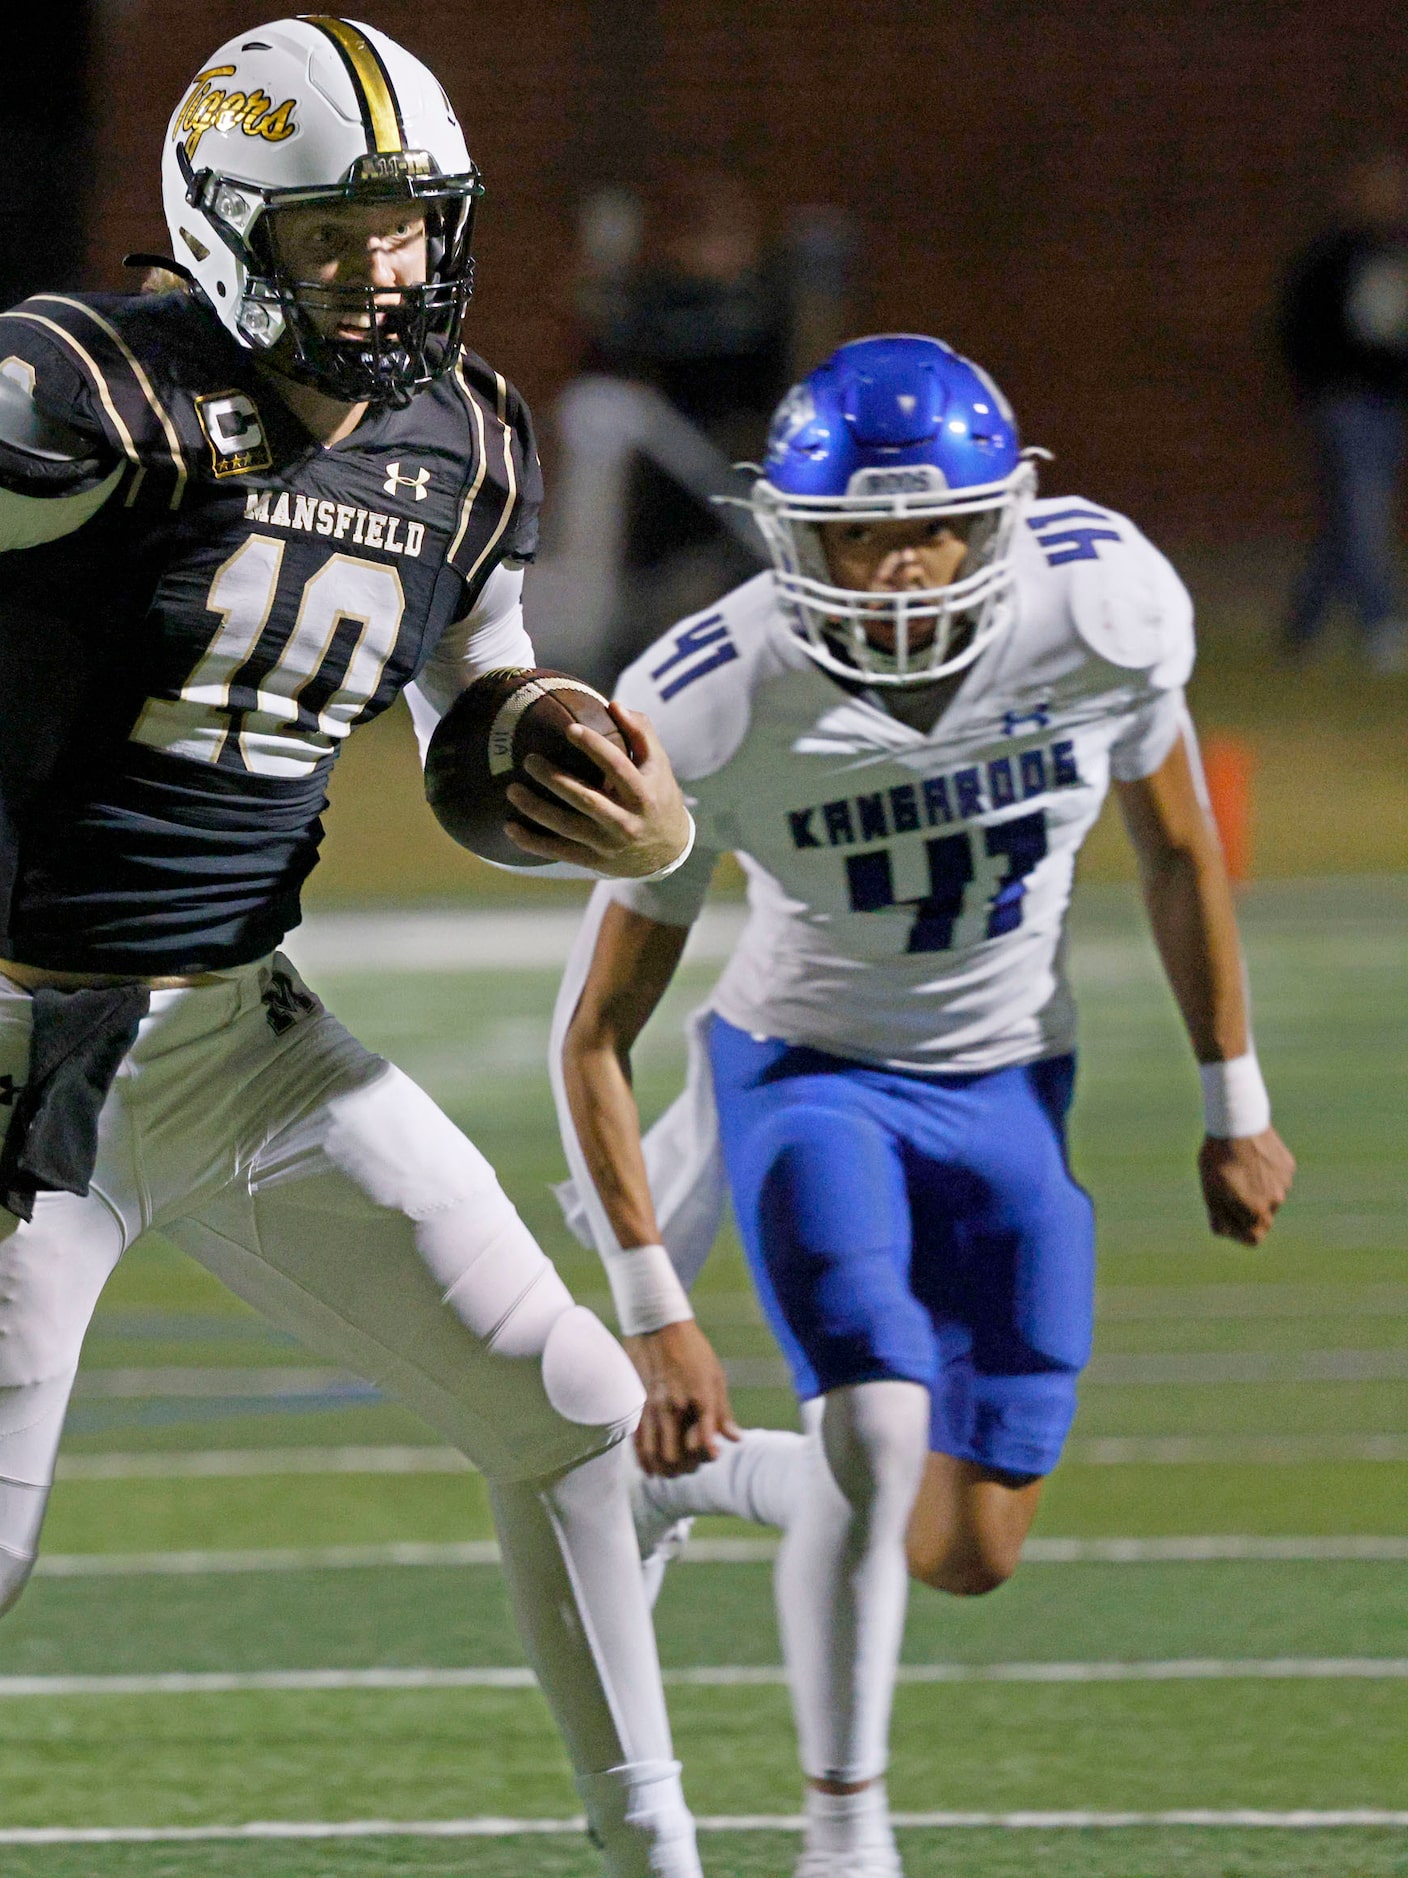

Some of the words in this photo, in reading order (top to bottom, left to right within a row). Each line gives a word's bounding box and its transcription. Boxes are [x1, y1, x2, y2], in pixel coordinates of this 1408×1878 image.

[171, 65, 297, 162] Tigers
[202, 395, 262, 455] C
[244, 488, 426, 558] MANSFIELD
[128, 533, 406, 779] 10
[650, 613, 739, 703] 41
[787, 740, 1082, 849] KANGAROOS
[845, 808, 1049, 952] 41
